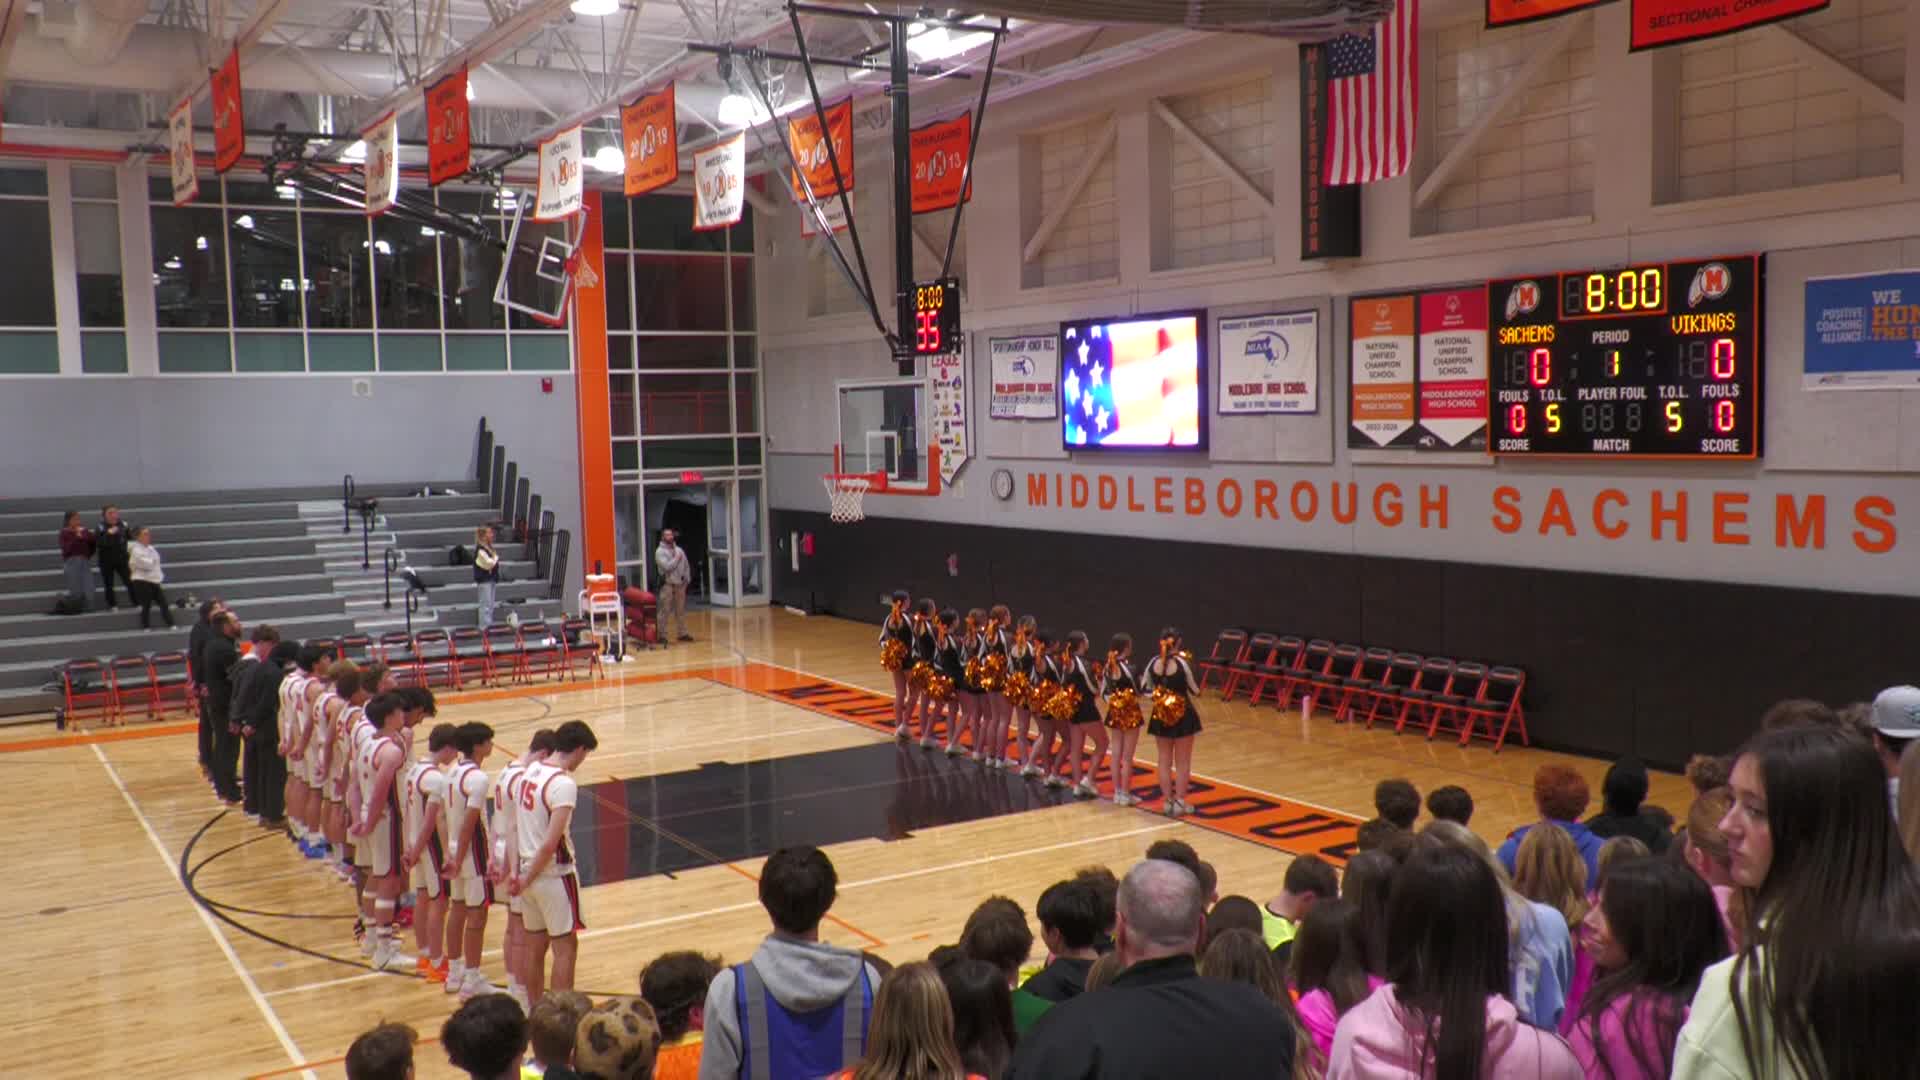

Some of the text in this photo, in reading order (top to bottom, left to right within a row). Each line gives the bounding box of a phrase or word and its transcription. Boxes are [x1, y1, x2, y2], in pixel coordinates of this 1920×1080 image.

[1648, 6, 1727, 30] SECTIONAL
[800, 148, 809, 166] 20
[915, 151, 961, 180] 20 13
[917, 285, 943, 310] 8:00
[1587, 269, 1660, 312] 8:00
[1872, 289, 1902, 305] WE
[1823, 307, 1863, 319] POSITIVE
[1671, 312, 1736, 334] VIKINGS
[1816, 320, 1863, 332] COACHING
[916, 310, 941, 351] 35
[1499, 325, 1555, 345] SACHEMS
[1592, 330, 1630, 343] PERIOD
[1434, 336, 1471, 346] NATIONAL
[1822, 332, 1863, 344] ALLIANCE
[1365, 342, 1399, 351] NATIONAL
[1438, 347, 1468, 356] UNIFIED
[1369, 351, 1396, 360] UNIFIED
[1433, 356, 1473, 366] CHAMPION
[1713, 338, 1735, 378] 0
[1364, 361, 1401, 370] CHAMPION
[1438, 367, 1468, 376] SCHOOL
[1531, 348, 1550, 384] 0
[1369, 370, 1396, 379] SCHOOL
[1283, 381, 1307, 394] SCHOOL
[1422, 389, 1485, 399] MIDDLEBOROUGH
[1540, 388, 1567, 401] T.O.L.
[1578, 386, 1647, 401] PLAYER FOUL
[1658, 385, 1688, 398] T.O.L.
[1702, 384, 1740, 398] FOULS
[1499, 389, 1529, 402] FOULS
[1428, 398, 1478, 409] HIGH SCHOOL
[1511, 404, 1526, 433] 0
[1546, 404, 1561, 433] 5
[1665, 401, 1683, 432] 5
[1717, 400, 1734, 432] 0
[1499, 439, 1530, 452] SCORE
[1593, 439, 1630, 452] MATCH
[1701, 439, 1740, 453] SCORE
[1027, 472, 1449, 529] MIDDLEBOROUGH
[1491, 485, 1897, 554] SACHEMS
[520, 779, 538, 812] 15
